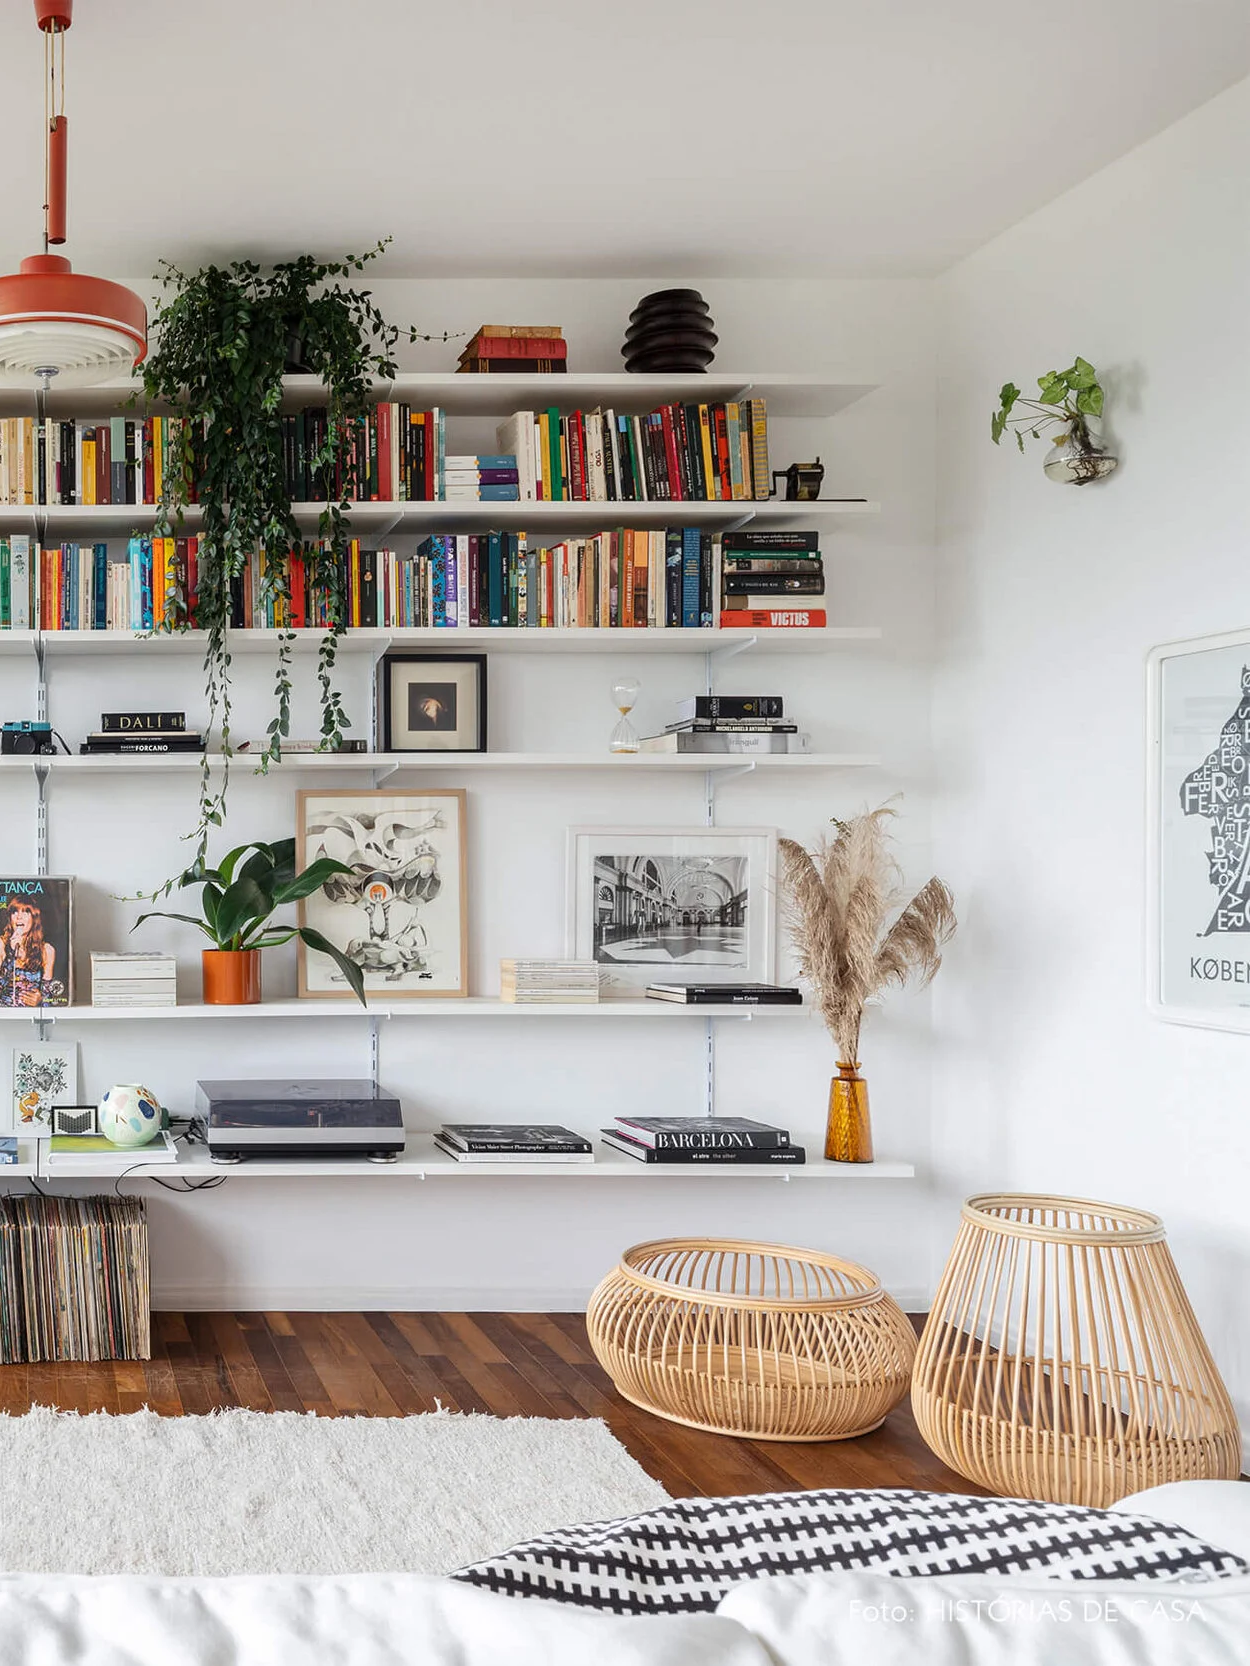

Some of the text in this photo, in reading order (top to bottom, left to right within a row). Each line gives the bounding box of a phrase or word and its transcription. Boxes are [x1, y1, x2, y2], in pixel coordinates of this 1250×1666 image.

[770, 612, 809, 626] VICTUS
[120, 714, 162, 729] DALÍ
[658, 1133, 754, 1148] BARCELONA
